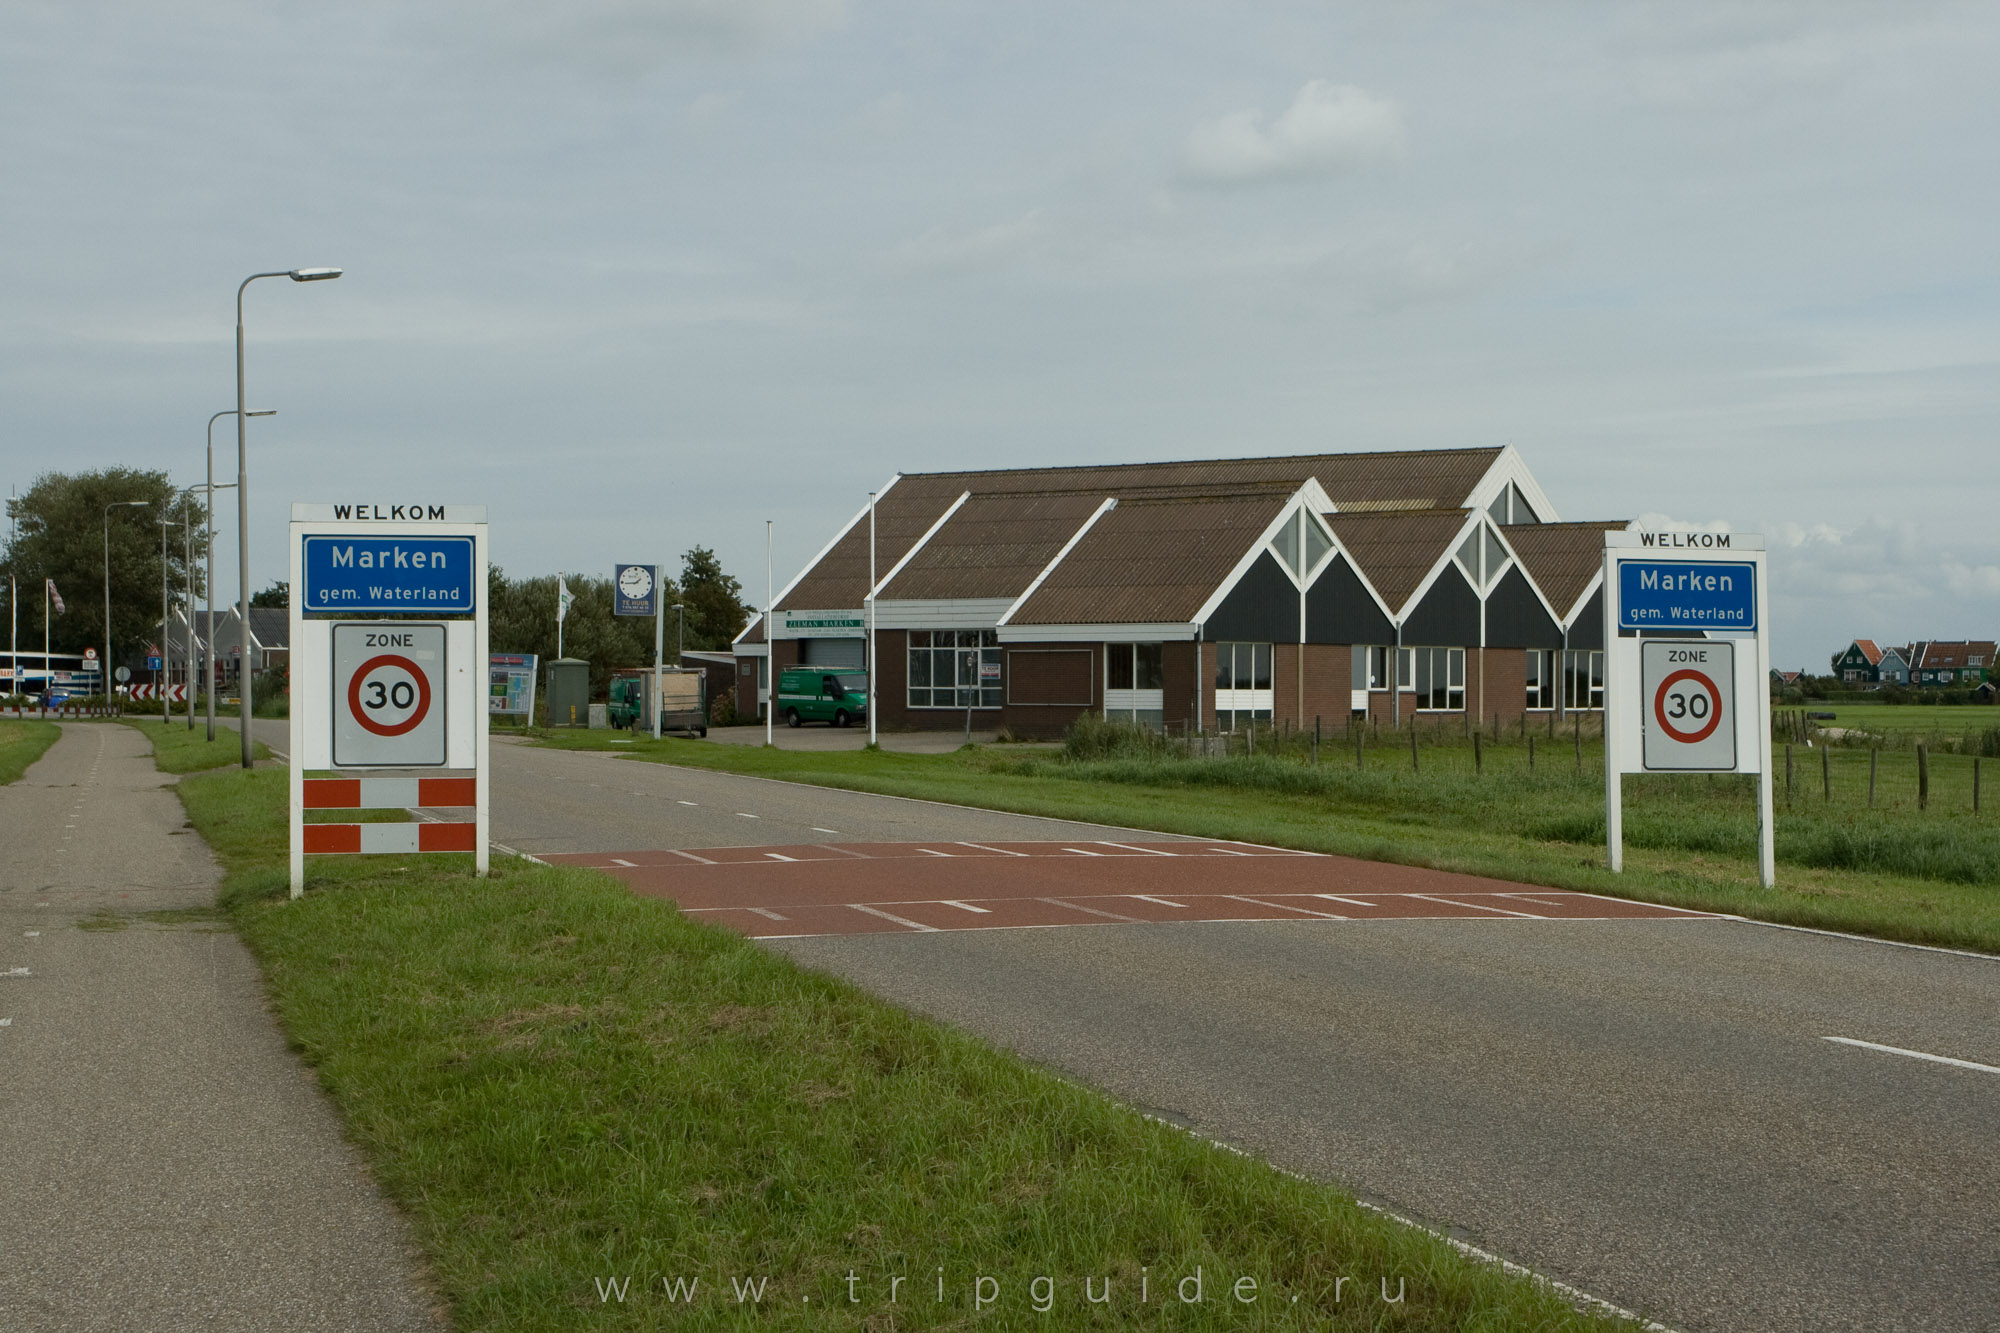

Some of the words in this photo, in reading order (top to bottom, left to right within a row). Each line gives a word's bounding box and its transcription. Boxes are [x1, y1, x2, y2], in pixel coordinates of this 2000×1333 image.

[334, 505, 446, 520] WELKOM
[1641, 533, 1731, 548] WELKOM
[332, 545, 447, 569] Marken
[1640, 570, 1733, 592] Marken
[319, 589, 361, 604] gem.
[369, 586, 460, 601] Waterland
[1630, 609, 1664, 622] gem.
[1670, 607, 1744, 620] Waterland
[822, 620, 855, 628] MARKEN
[366, 634, 413, 647] ZONE
[1668, 650, 1708, 663] ZONE
[365, 681, 414, 710] 30
[1668, 693, 1709, 719] 30
